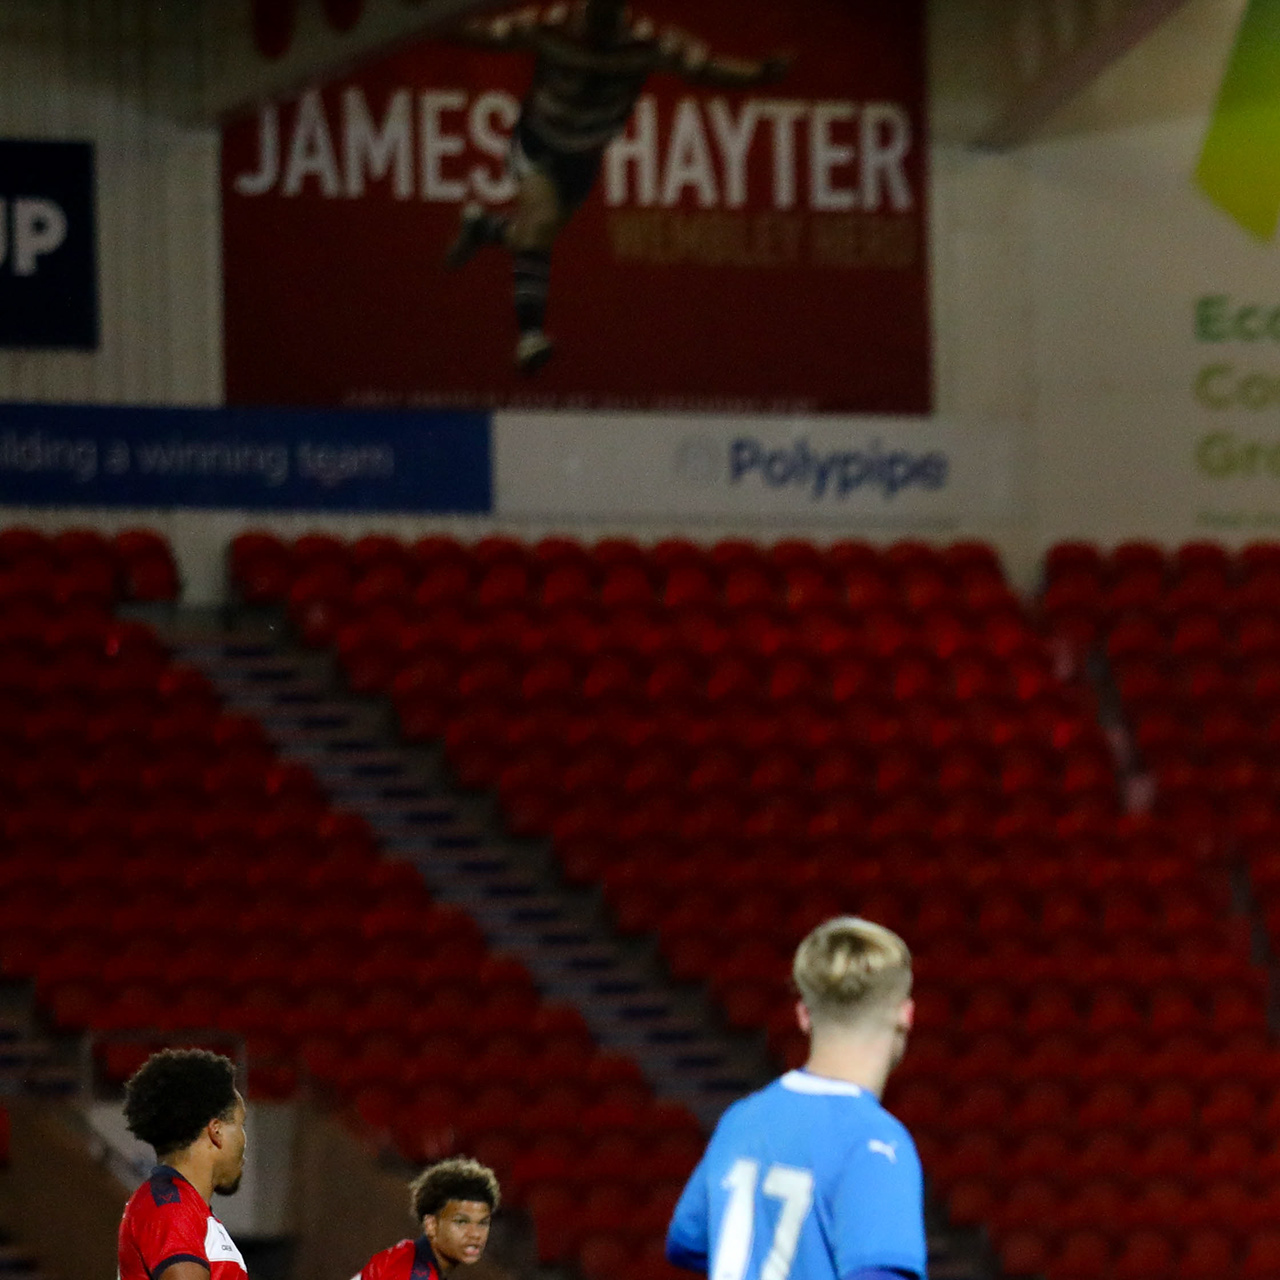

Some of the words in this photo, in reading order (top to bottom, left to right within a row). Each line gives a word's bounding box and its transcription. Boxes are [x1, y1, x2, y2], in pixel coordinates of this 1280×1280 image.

[234, 87, 522, 203] JAMES
[605, 93, 914, 212] HAYTER
[0, 194, 69, 278] P
[730, 434, 948, 503] Polypipe
